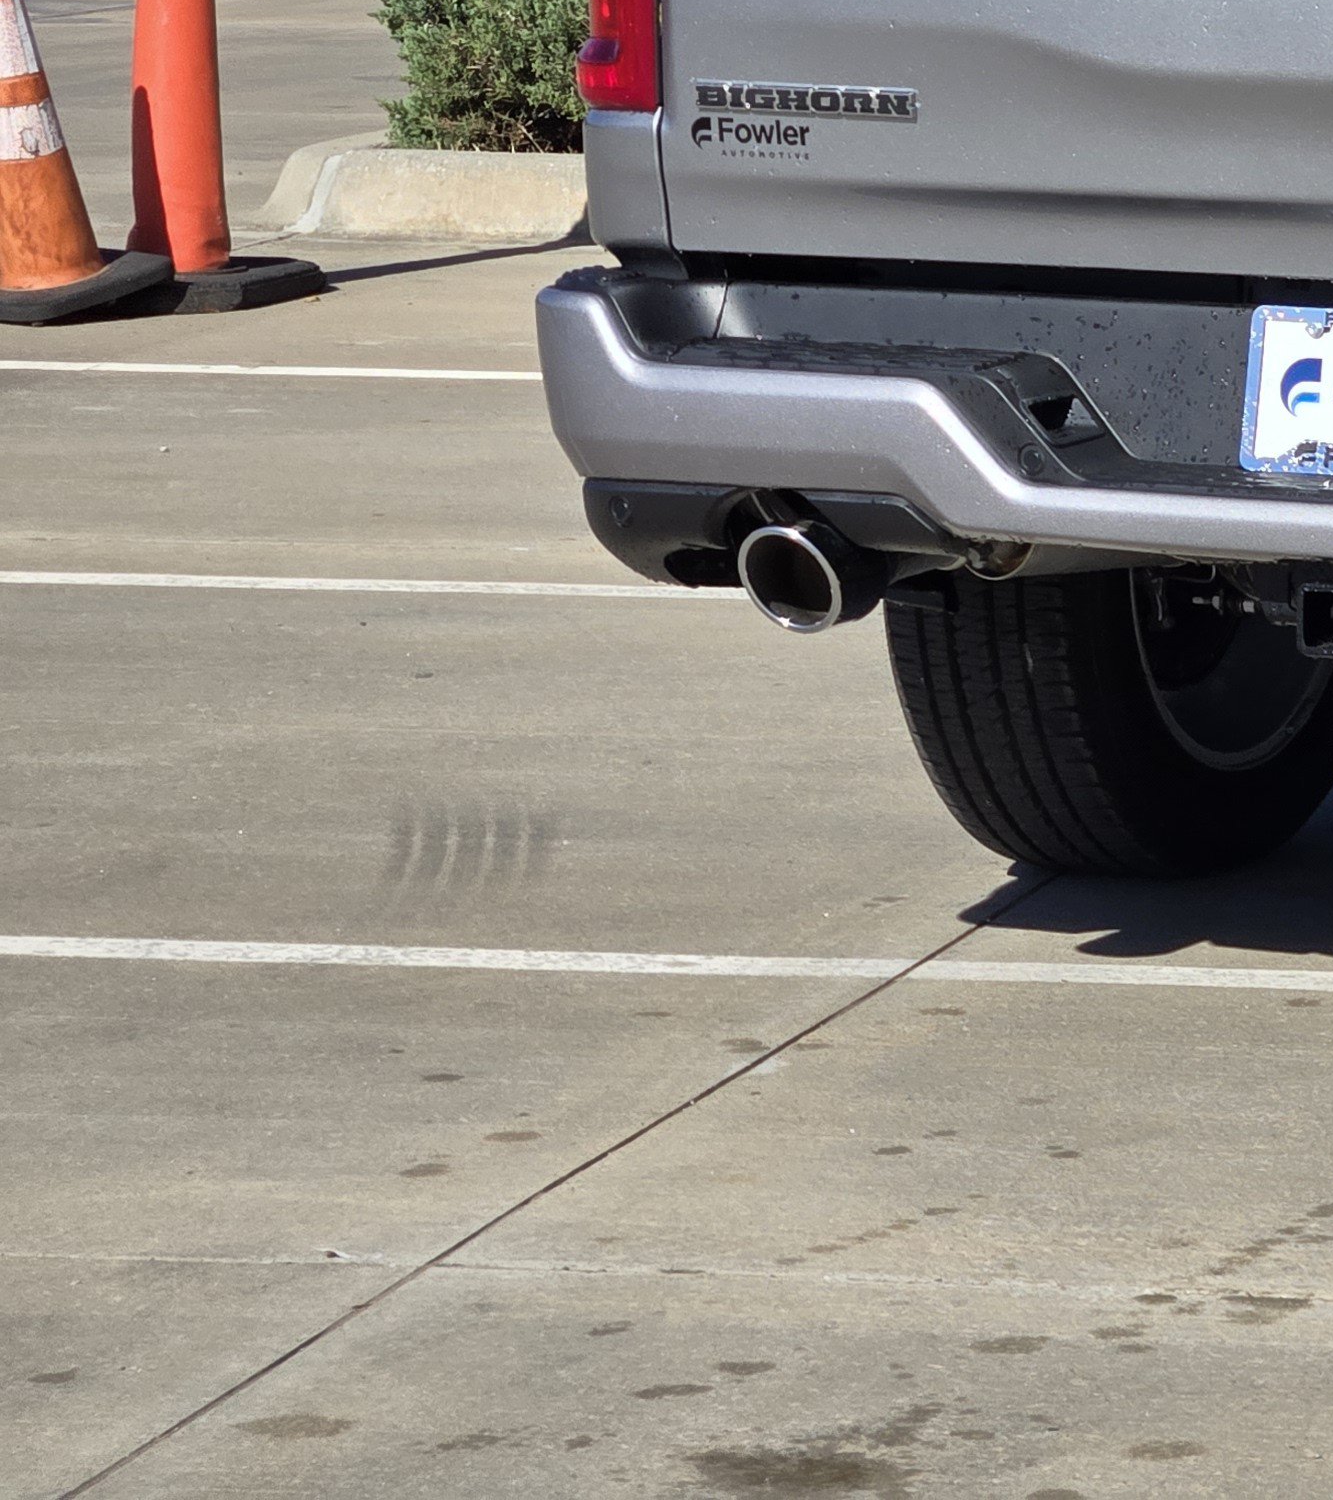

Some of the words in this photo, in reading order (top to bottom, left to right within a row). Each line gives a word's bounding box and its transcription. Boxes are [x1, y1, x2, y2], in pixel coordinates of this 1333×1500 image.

[694, 80, 917, 120] BIGHORN
[717, 116, 810, 146] Fowler
[721, 149, 810, 160] AUTOMOTIVE
